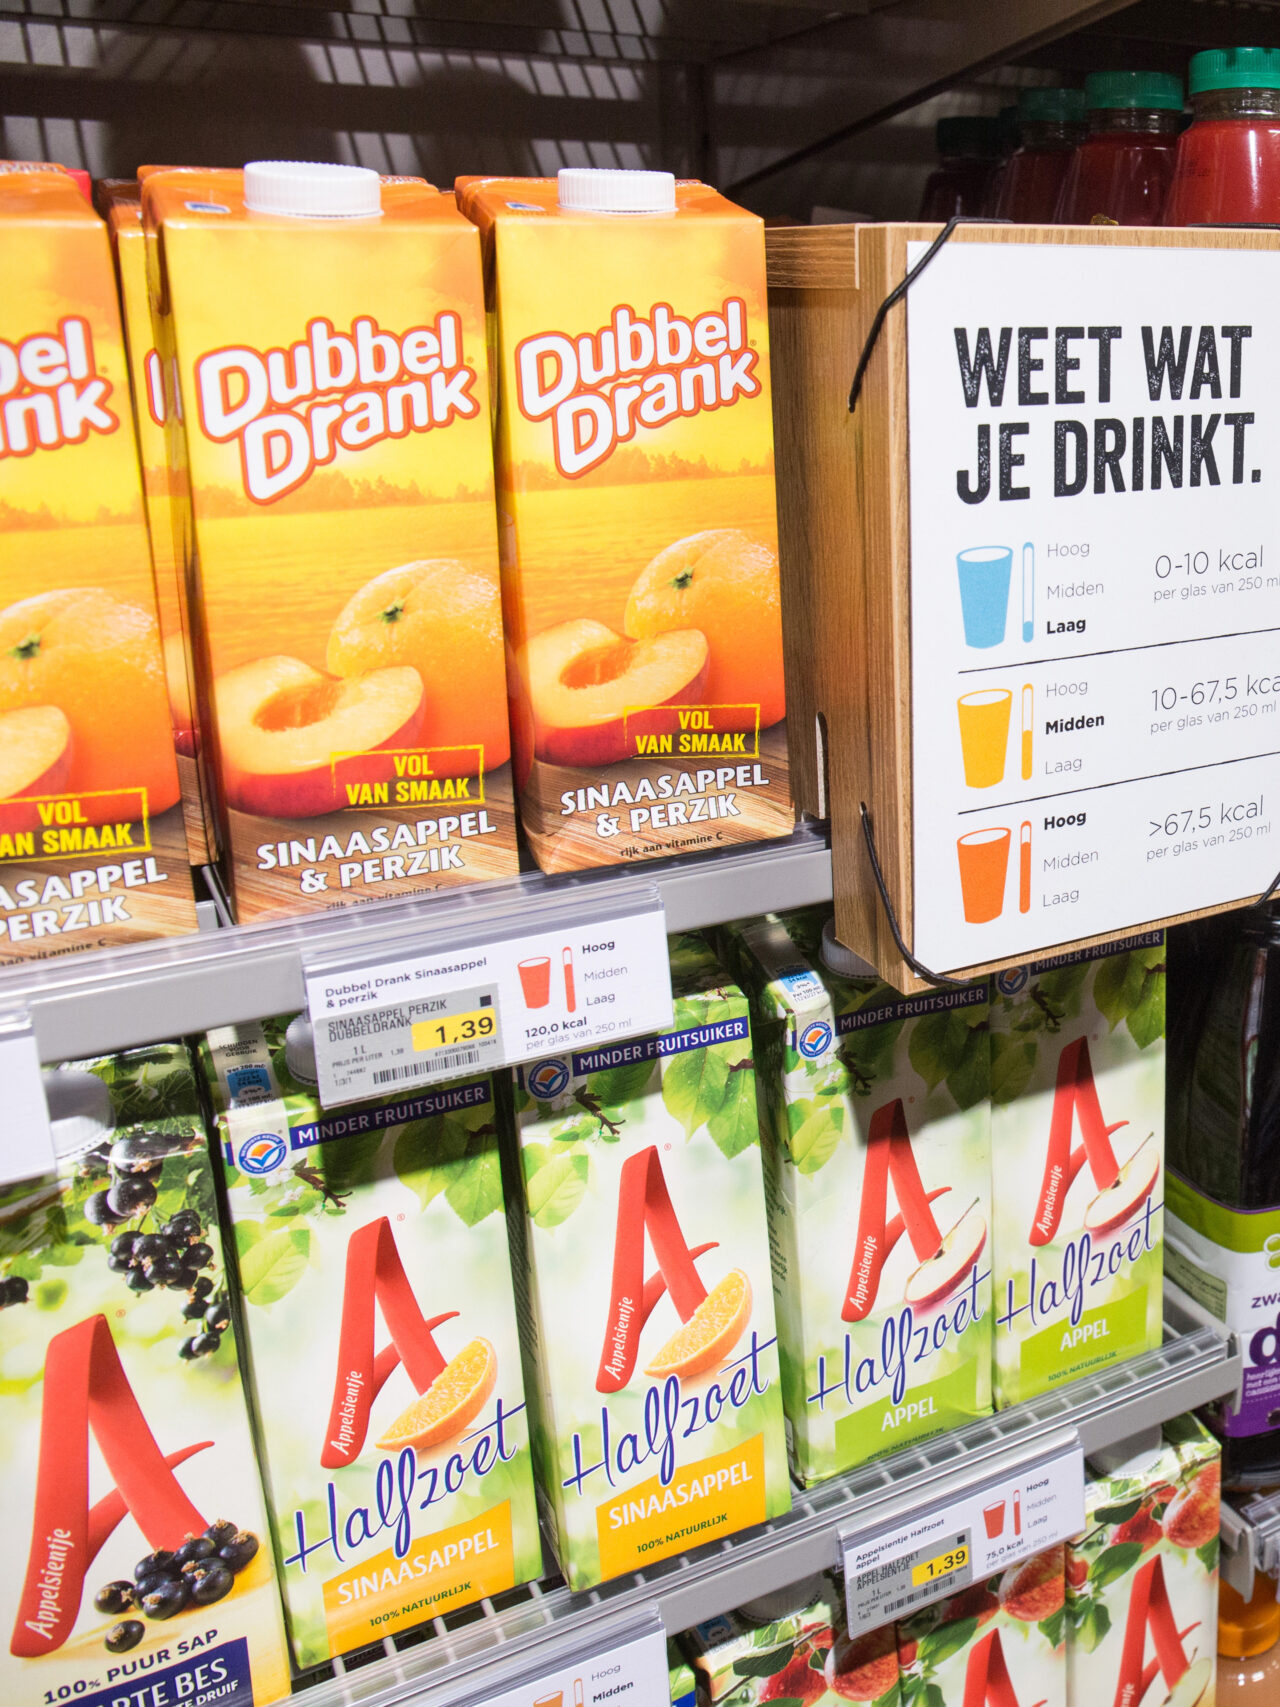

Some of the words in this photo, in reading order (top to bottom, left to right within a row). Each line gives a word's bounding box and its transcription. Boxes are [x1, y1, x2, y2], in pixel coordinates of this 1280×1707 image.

[519, 300, 743, 417] Dubbel
[954, 326, 1122, 407] WEET
[1141, 325, 1252, 401] WAT
[199, 314, 458, 439] Dubbel
[556, 351, 757, 475] Drank
[243, 369, 474, 501] Drank
[956, 422, 1030, 505] JE
[1054, 412, 1261, 497] DRINKT.
[1047, 542, 1091, 559] Hoog
[1155, 551, 1209, 579] 0-10
[1219, 546, 1264, 572] kcal
[1047, 581, 1105, 600] Midden
[1153, 588, 1177, 603] per
[1180, 582, 1207, 601] glas
[1211, 582, 1234, 594] van
[1238, 577, 1263, 592] 250
[1046, 618, 1087, 635] Laag
[1046, 680, 1089, 698] Hoog
[1151, 677, 1238, 711] 10-67,5
[679, 711, 714, 730] VOL
[1045, 713, 1105, 736] Midden
[1150, 719, 1174, 735] per
[1177, 712, 1203, 731] glas
[1207, 710, 1230, 723] van
[1233, 704, 1258, 719] 250
[1261, 700, 1277, 714] ml
[635, 734, 673, 754] VAN
[679, 733, 747, 753] SMAAK
[393, 754, 435, 777] VOL
[1045, 757, 1083, 775] Laag
[345, 782, 390, 806] VAN
[396, 778, 470, 803] SMAAK
[560, 763, 770, 816] SINAASAPPEL
[37, 800, 88, 826] VOL
[596, 812, 622, 838] &
[630, 793, 741, 833] PERZIK
[1044, 811, 1087, 831] Hoog
[1149, 806, 1212, 838] >67,5
[1221, 795, 1264, 824] kcal
[42, 823, 135, 855] SMAAK
[256, 809, 498, 871] SINAASAPPEL
[620, 843, 639, 858] rijk
[643, 843, 663, 853] aan
[664, 834, 713, 849] vitamine
[716, 832, 723, 841] C
[1146, 846, 1169, 862] per
[1173, 837, 1198, 857] glas
[1202, 834, 1226, 848] van
[1228, 827, 1253, 843] 250
[1256, 822, 1271, 836] ml
[300, 867, 330, 894] &
[339, 843, 466, 889] PERZIK
[1043, 849, 1099, 873] Midden
[1042, 888, 1080, 908] Laag
[582, 940, 615, 954] Hoog
[325, 980, 371, 997] Dubbel
[375, 974, 411, 988] Drank
[415, 957, 487, 980] Sinaasappel
[584, 965, 628, 982] Midden
[339, 992, 378, 1008] perzik
[409, 999, 447, 1016] PERZIK
[586, 993, 616, 1007] Laag
[841, 1006, 893, 1032] MINDER
[897, 988, 985, 1017] FRUITSUIKER
[328, 1017, 412, 1042] DUBBELDRANK
[435, 1016, 494, 1044] 1,39
[525, 1023, 559, 1038] 120,0
[563, 1017, 587, 1031] kcal
[526, 1039, 544, 1051] per
[547, 1034, 570, 1047] glas
[573, 1029, 592, 1039] van
[595, 1024, 616, 1035] 250
[619, 1018, 632, 1031] ml
[580, 1043, 643, 1072] MINDER
[647, 1021, 744, 1056] FRUITSUIKER
[298, 1114, 370, 1145] MINDER
[375, 1085, 485, 1126] FRUITSUIKER
[1036, 1164, 1064, 1237] Appelsientje
[849, 1234, 878, 1312] Appelsientje
[996, 1196, 1166, 1332] Halfzoet
[604, 1295, 635, 1381] Appelsientje
[807, 1264, 993, 1412] Halfzoet
[1061, 1317, 1111, 1351] APPEL
[330, 1370, 365, 1456] Appelsientje
[562, 1330, 778, 1496] Halfzoet
[881, 1396, 938, 1432] APPEL
[284, 1397, 527, 1573] Halfzoet
[608, 1460, 753, 1530] SINAASAPPEL
[1026, 1478, 1050, 1493] Hoog
[1026, 1493, 1057, 1512] Midden
[637, 1537, 664, 1553] 100%
[665, 1512, 728, 1544] NATUURLIJK
[1027, 1514, 1048, 1529] Laag
[856, 1533, 909, 1563] Appelsientje
[911, 1518, 945, 1538] Halfzoet
[986, 1547, 1005, 1561] 75,0
[1006, 1538, 1024, 1554] kcal
[337, 1527, 499, 1605] SINAASAPPEL
[856, 1554, 880, 1570] appel
[926, 1550, 966, 1577] 1,39
[24, 1527, 76, 1640] Appelsientje
[369, 1609, 400, 1627] 100%
[402, 1580, 472, 1615] NATUURLIJK
[44, 1679, 102, 1706] 100%
[106, 1649, 171, 1683] PUUR
[177, 1628, 220, 1656] SAP
[173, 1657, 229, 1699] BES
[591, 1664, 621, 1682] Hoog
[195, 1680, 239, 1706] DRUIF
[593, 1680, 634, 1704] Midden
